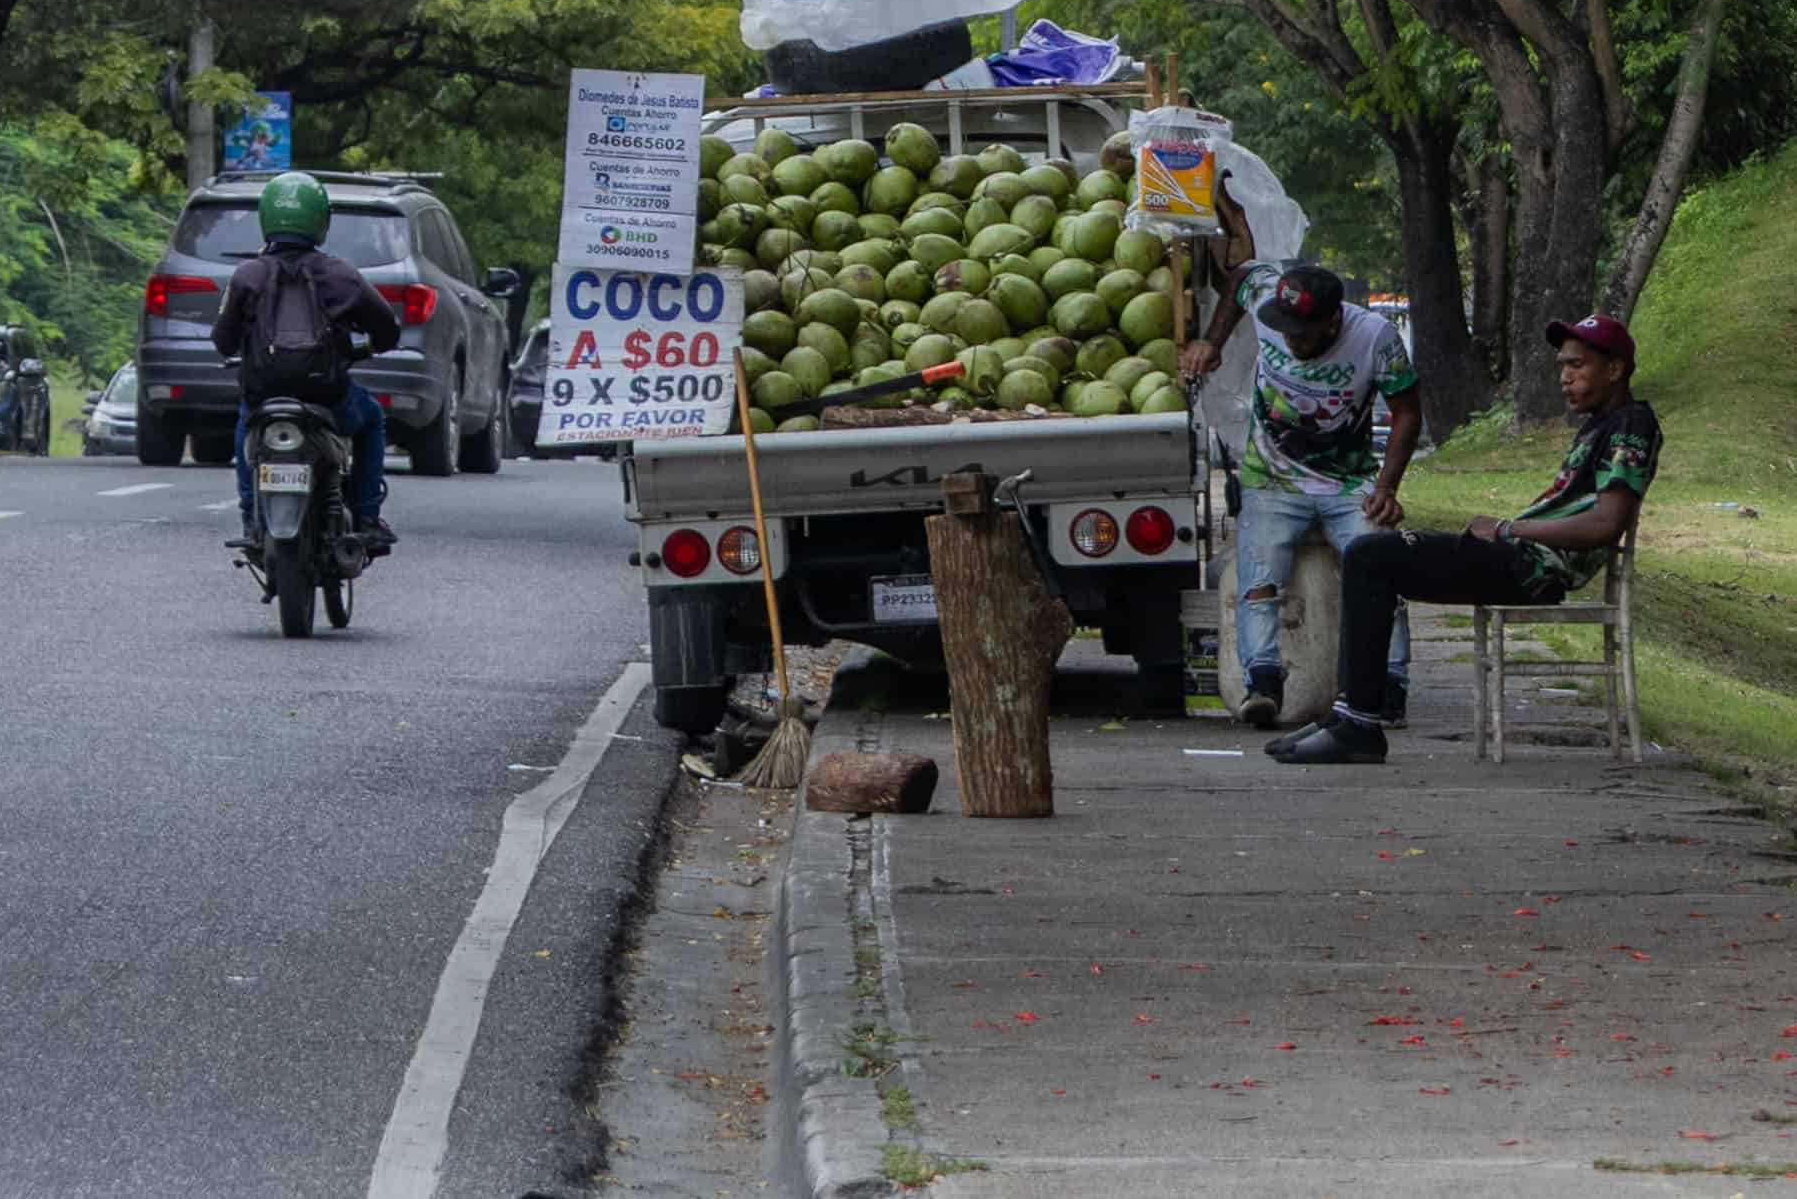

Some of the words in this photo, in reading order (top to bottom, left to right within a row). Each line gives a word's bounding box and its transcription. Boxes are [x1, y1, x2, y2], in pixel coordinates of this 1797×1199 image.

[578, 88, 625, 105] Diomedes
[627, 94, 638, 106] de
[668, 95, 699, 109] Batista
[602, 105, 641, 117] Cuentas
[645, 109, 677, 120] Ahorro
[588, 132, 685, 151] 846665602
[589, 161, 630, 174] Cuentas
[632, 165, 644, 175] de
[647, 166, 680, 177] Ahorro
[1145, 194, 1169, 206] 500
[585, 213, 625, 225] Cuentas
[627, 216, 639, 226] de
[642, 217, 677, 229] Ahorro
[626, 230, 658, 243] BHD
[566, 270, 724, 322] COCO
[565, 330, 602, 370] A
[622, 328, 719, 373] $60
[552, 378, 575, 407] 9
[587, 377, 615, 406] X
[628, 374, 723, 407] $500
[559, 411, 612, 430] POR
[622, 409, 705, 429] FAVOR
